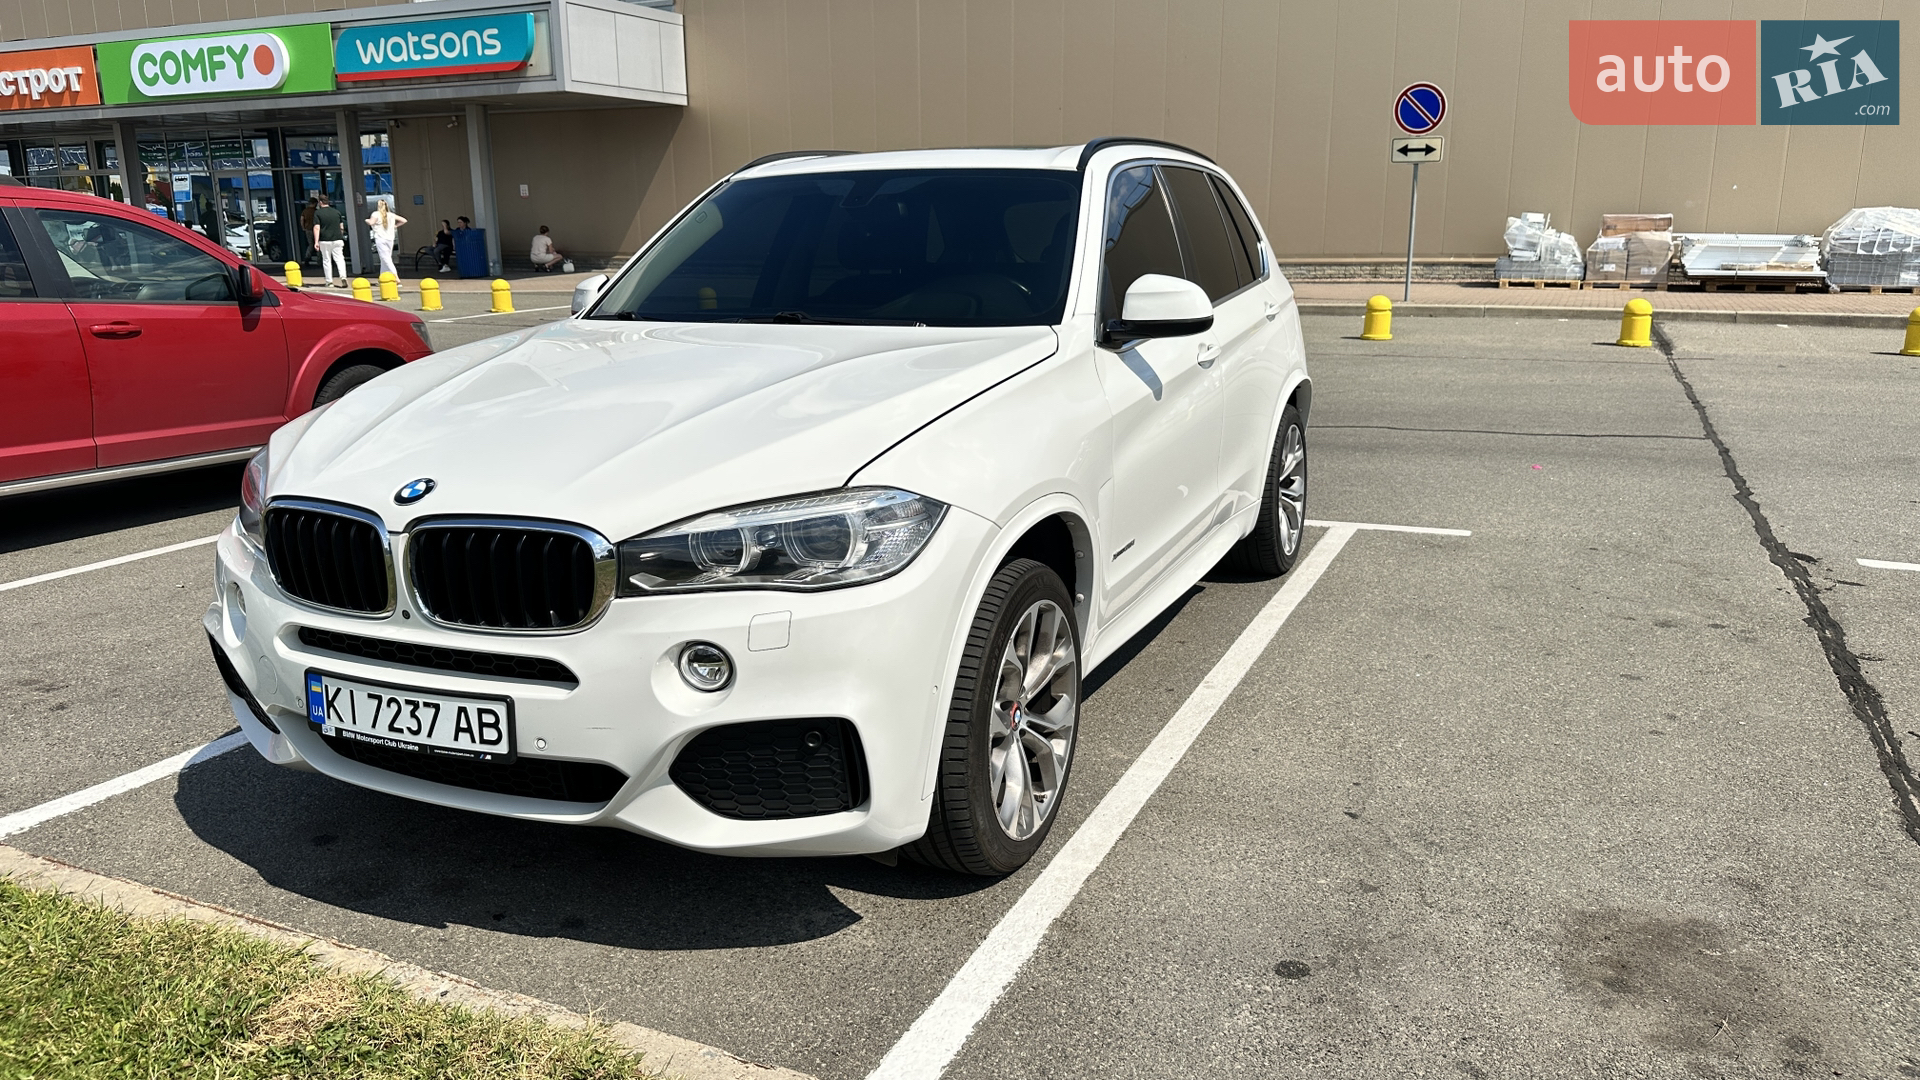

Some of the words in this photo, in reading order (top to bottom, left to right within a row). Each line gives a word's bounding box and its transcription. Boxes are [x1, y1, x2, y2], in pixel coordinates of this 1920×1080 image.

[137, 43, 249, 87] COMFY
[356, 28, 501, 65] watsons
[312, 705, 323, 717] UA
[325, 684, 356, 725] KI
[368, 692, 441, 738] 7237
[453, 706, 503, 746] AB
